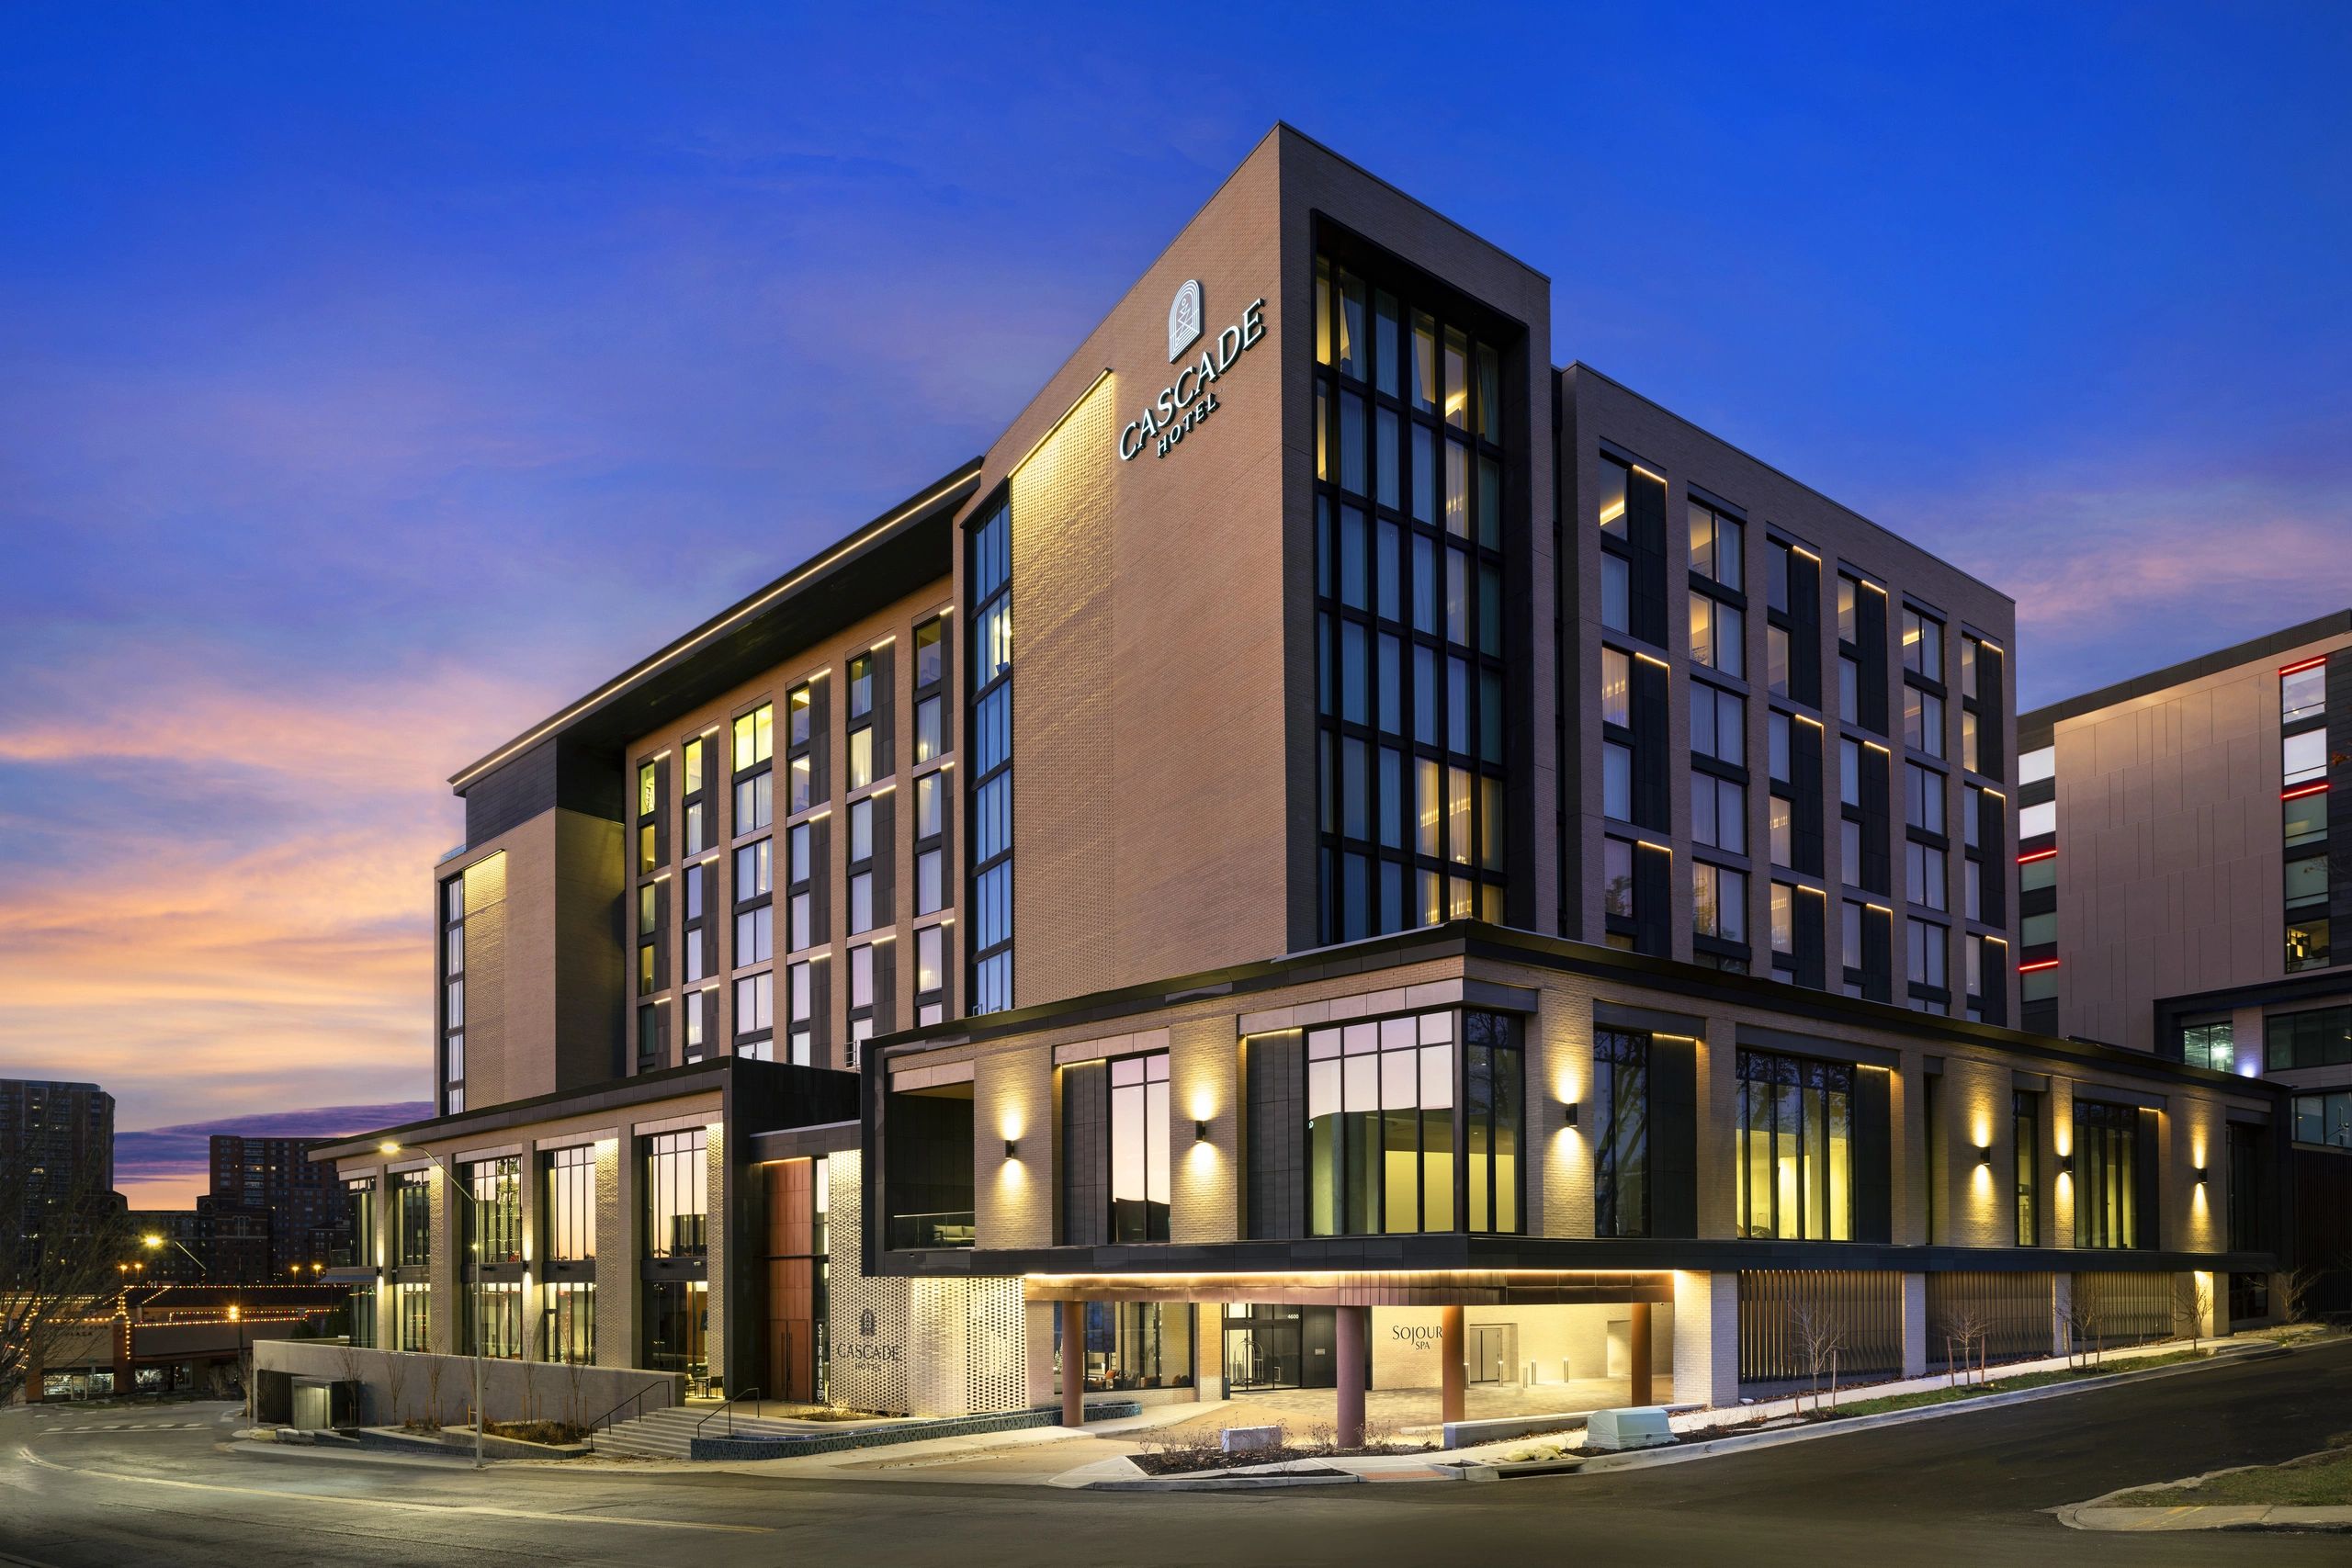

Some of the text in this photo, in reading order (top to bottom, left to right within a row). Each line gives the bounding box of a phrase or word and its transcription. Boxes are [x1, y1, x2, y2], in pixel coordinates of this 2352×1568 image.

[1119, 298, 1266, 460] CASCADE
[1157, 392, 1220, 458] HOTEL
[1392, 1325, 1443, 1345] SOJOUR
[837, 1343, 900, 1360] CASCADE
[1415, 1341, 1430, 1350] SPA
[854, 1362, 881, 1372] HOTEL
